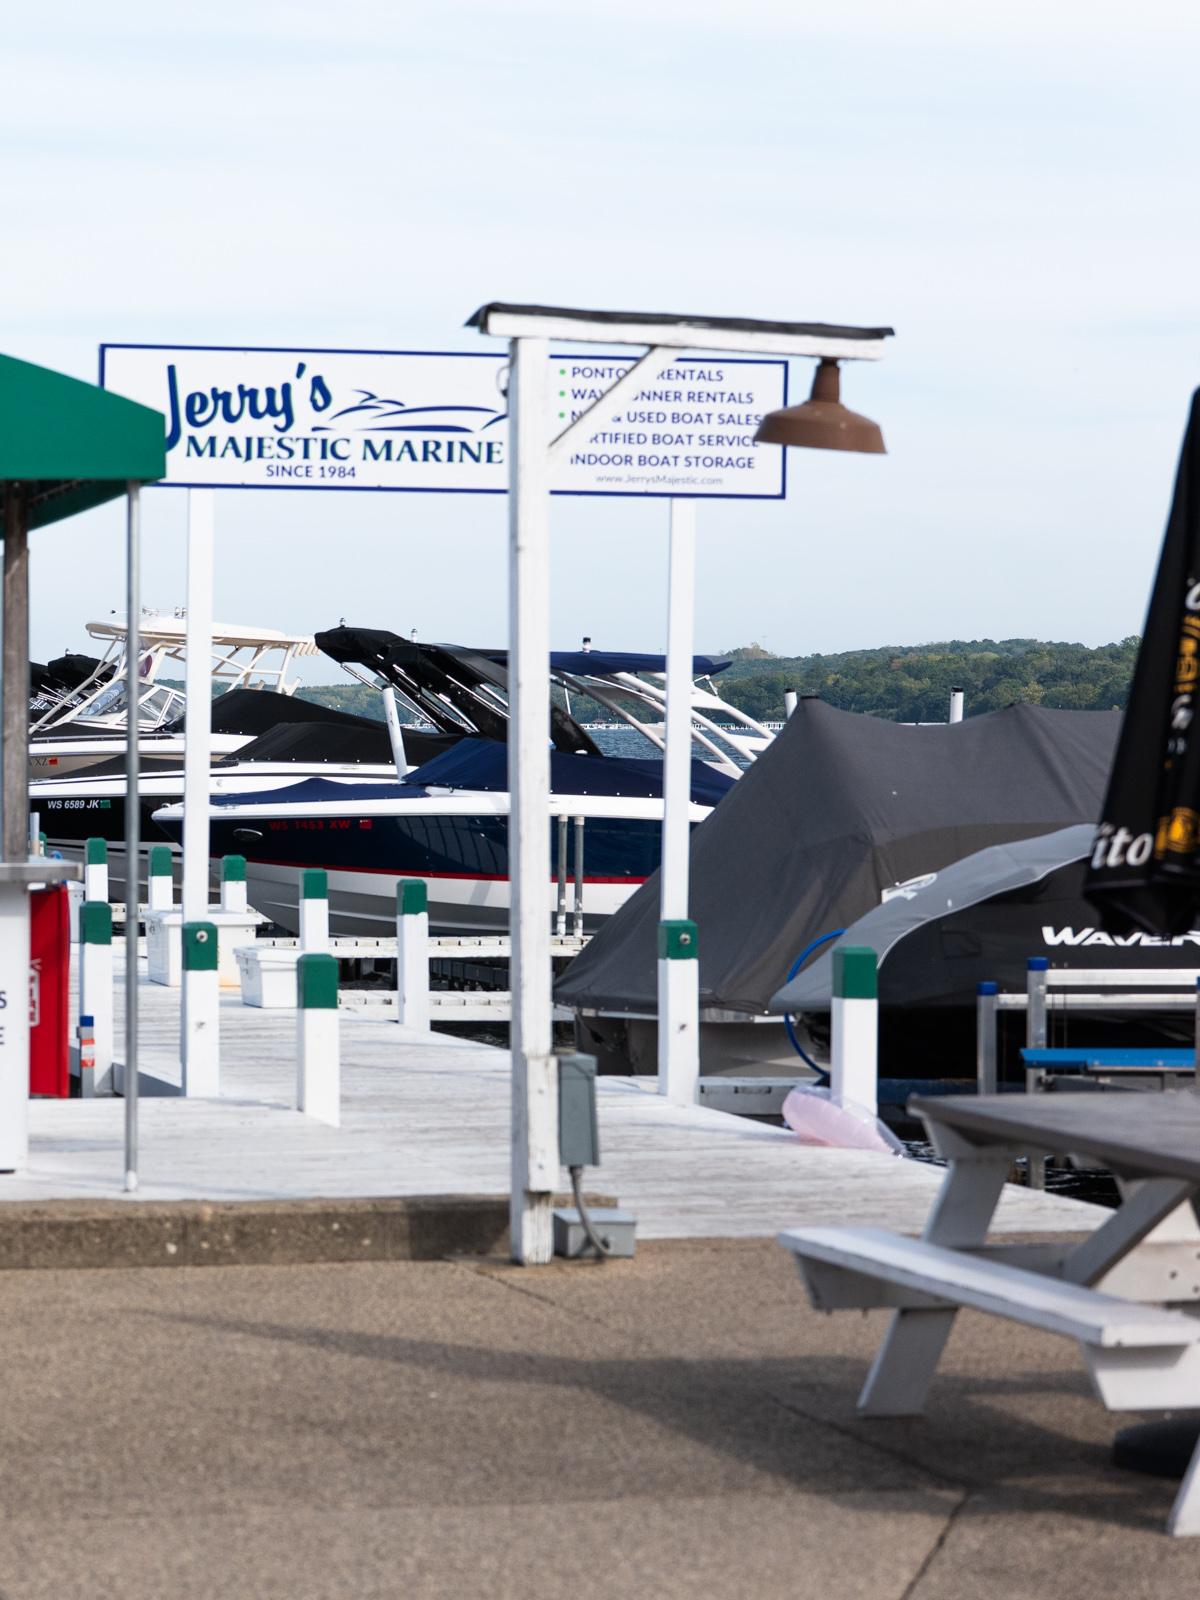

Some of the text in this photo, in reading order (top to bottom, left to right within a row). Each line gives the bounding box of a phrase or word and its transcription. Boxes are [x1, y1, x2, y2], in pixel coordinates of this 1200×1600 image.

[571, 366, 629, 379] PONTO
[686, 391, 755, 404] RENTALS
[165, 361, 332, 453] Jerry's
[626, 411, 667, 424] USED
[671, 412, 713, 425] BOAT
[717, 413, 763, 426] SALES
[589, 432, 647, 446] RTIFIED
[651, 432, 694, 446] BOAT
[186, 435, 504, 464] MAJESTIC MARINE
[637, 455, 680, 468] BOAT
[683, 456, 756, 470] STORAGE
[266, 464, 356, 479] SINCE 1984
[47, 800, 100, 809] WS 6589 JK
[268, 821, 289, 831] WS
